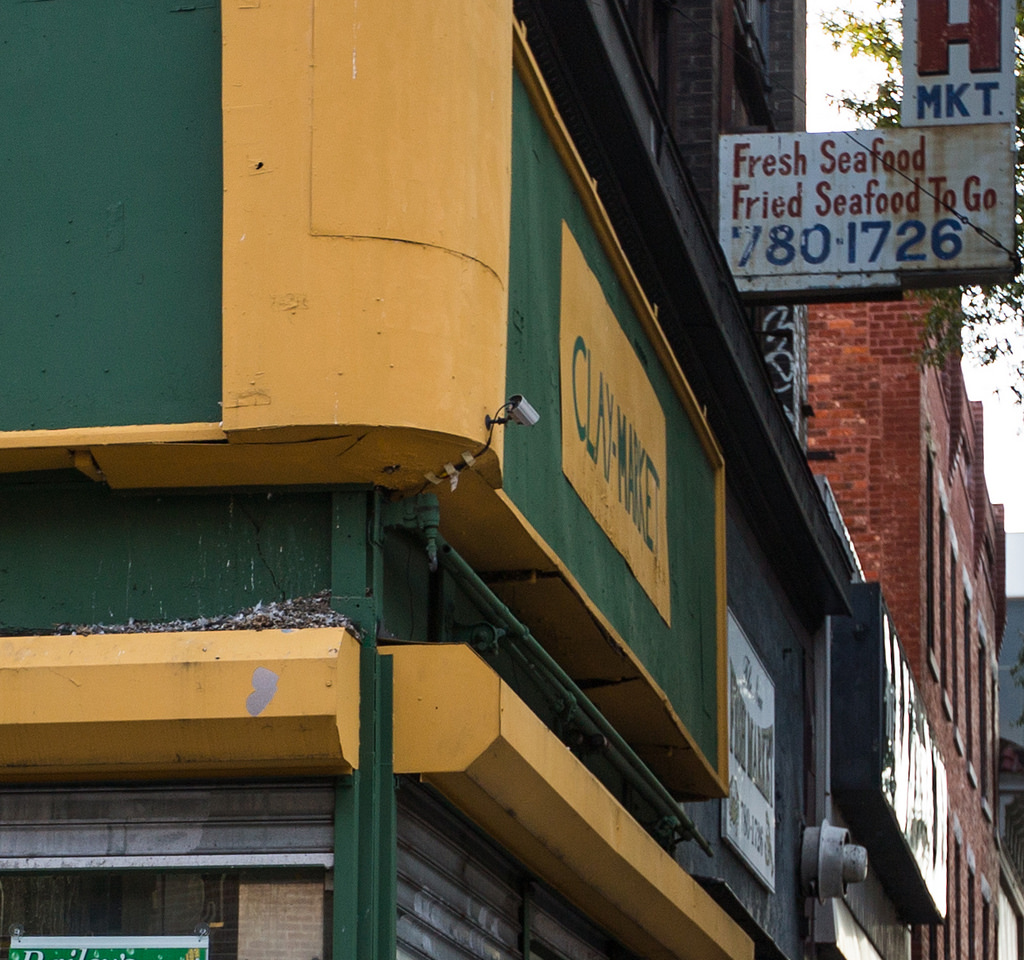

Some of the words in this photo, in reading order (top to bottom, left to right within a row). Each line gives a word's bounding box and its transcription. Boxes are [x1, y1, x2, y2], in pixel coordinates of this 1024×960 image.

[918, 0, 1001, 76] H
[733, 141, 807, 177] Fresh
[820, 135, 926, 173] Seafood
[732, 182, 803, 220] Fried
[815, 178, 920, 216] Seafood
[928, 177, 956, 213] To
[963, 176, 997, 212] Go
